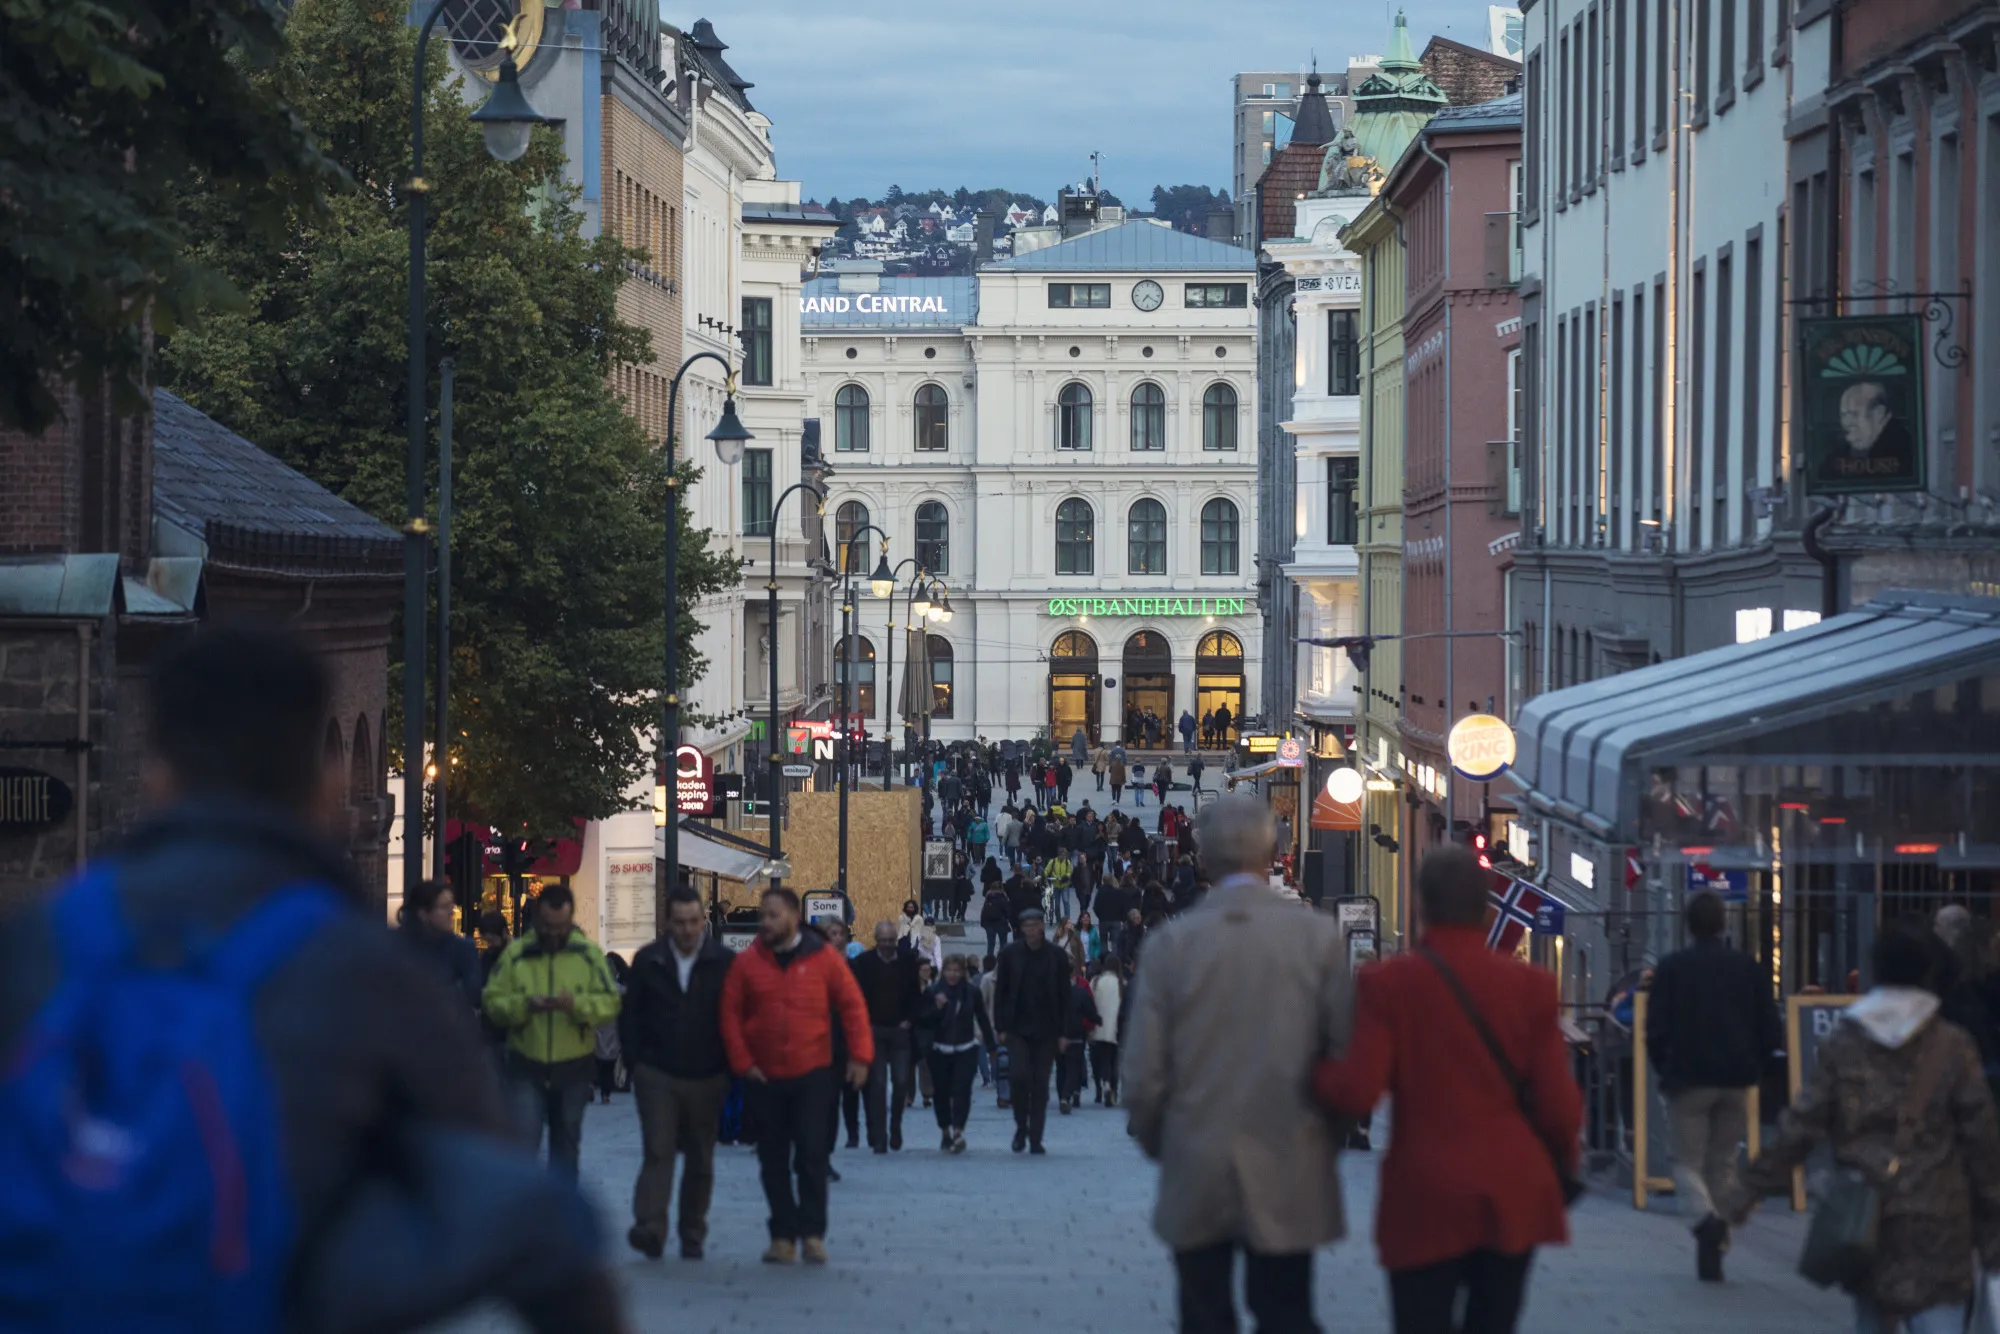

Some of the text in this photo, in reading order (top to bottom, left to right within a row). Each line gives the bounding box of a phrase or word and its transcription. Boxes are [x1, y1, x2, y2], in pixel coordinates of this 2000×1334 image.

[1049, 598, 1245, 616] ØSTBANEHALLEN
[814, 739, 834, 760] N
[1455, 739, 1508, 762] KING
[610, 863, 653, 873] 25 SHOPS
[812, 901, 838, 911] Sone
